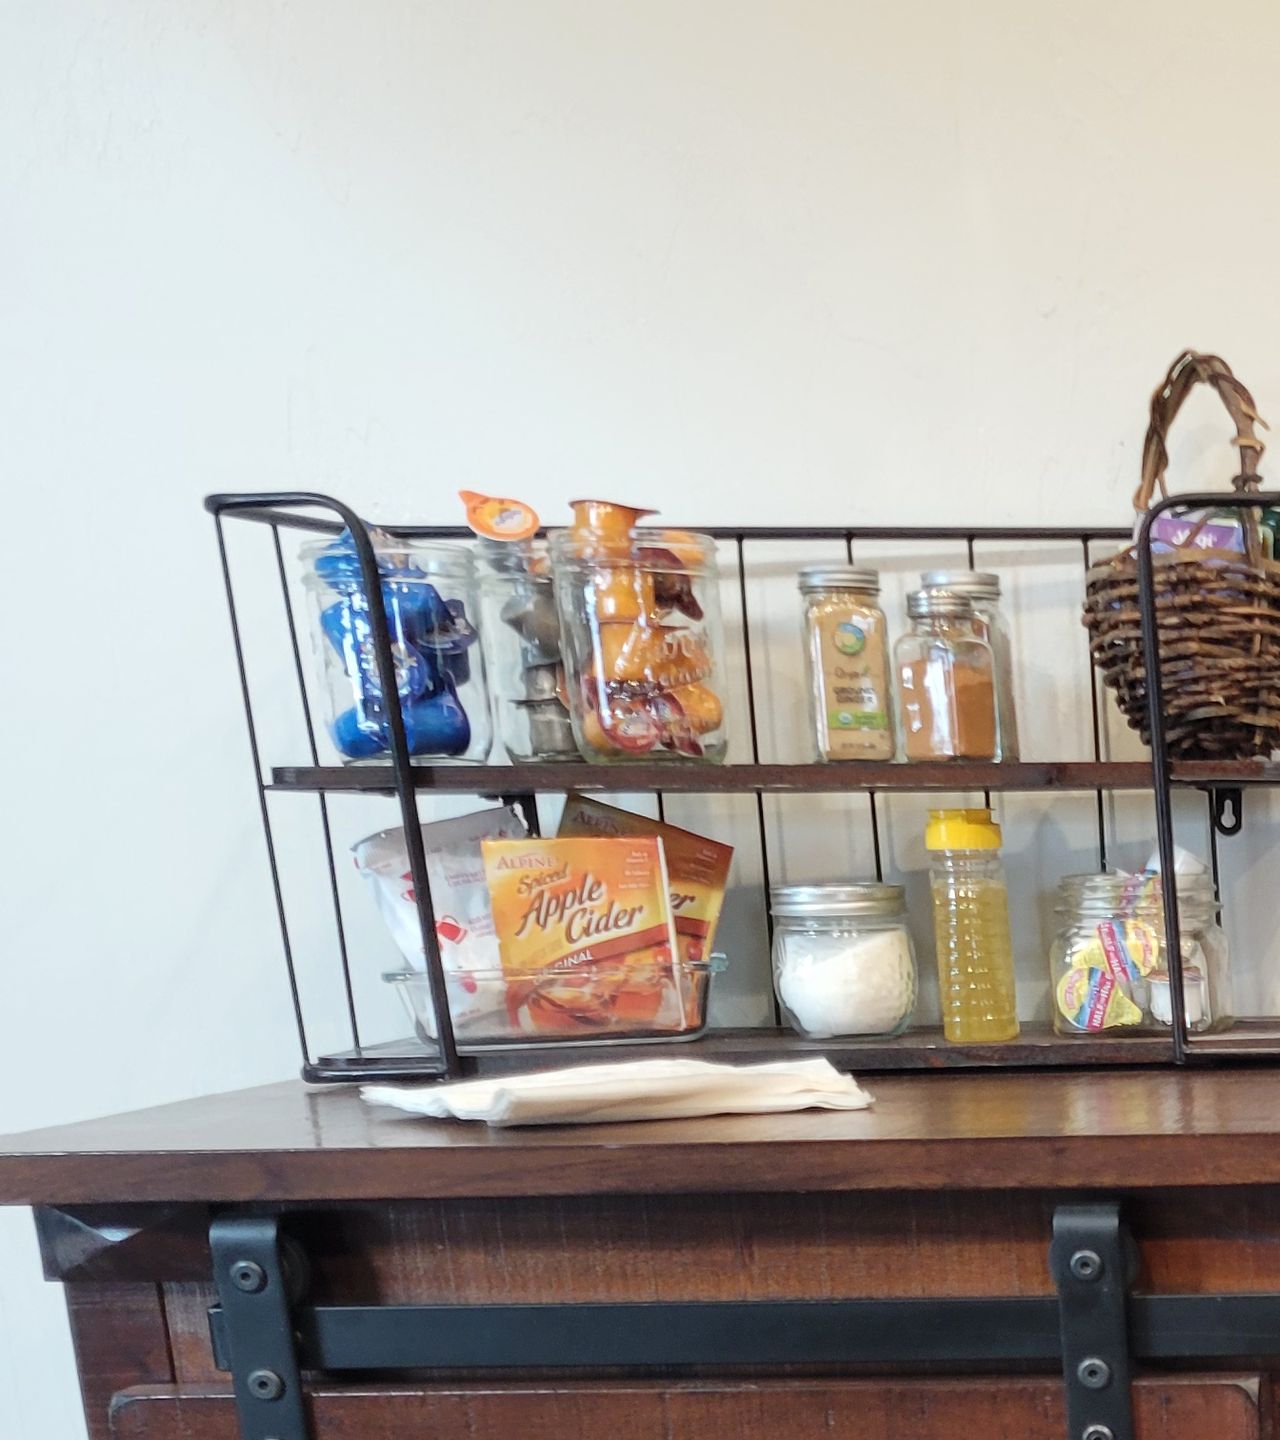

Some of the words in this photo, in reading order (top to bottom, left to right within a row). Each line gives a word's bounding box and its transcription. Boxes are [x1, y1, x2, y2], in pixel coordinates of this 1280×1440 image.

[1171, 528, 1217, 549] Ygi
[516, 862, 568, 896] Spiced
[515, 873, 604, 937] Apple
[565, 900, 643, 944] Cider
